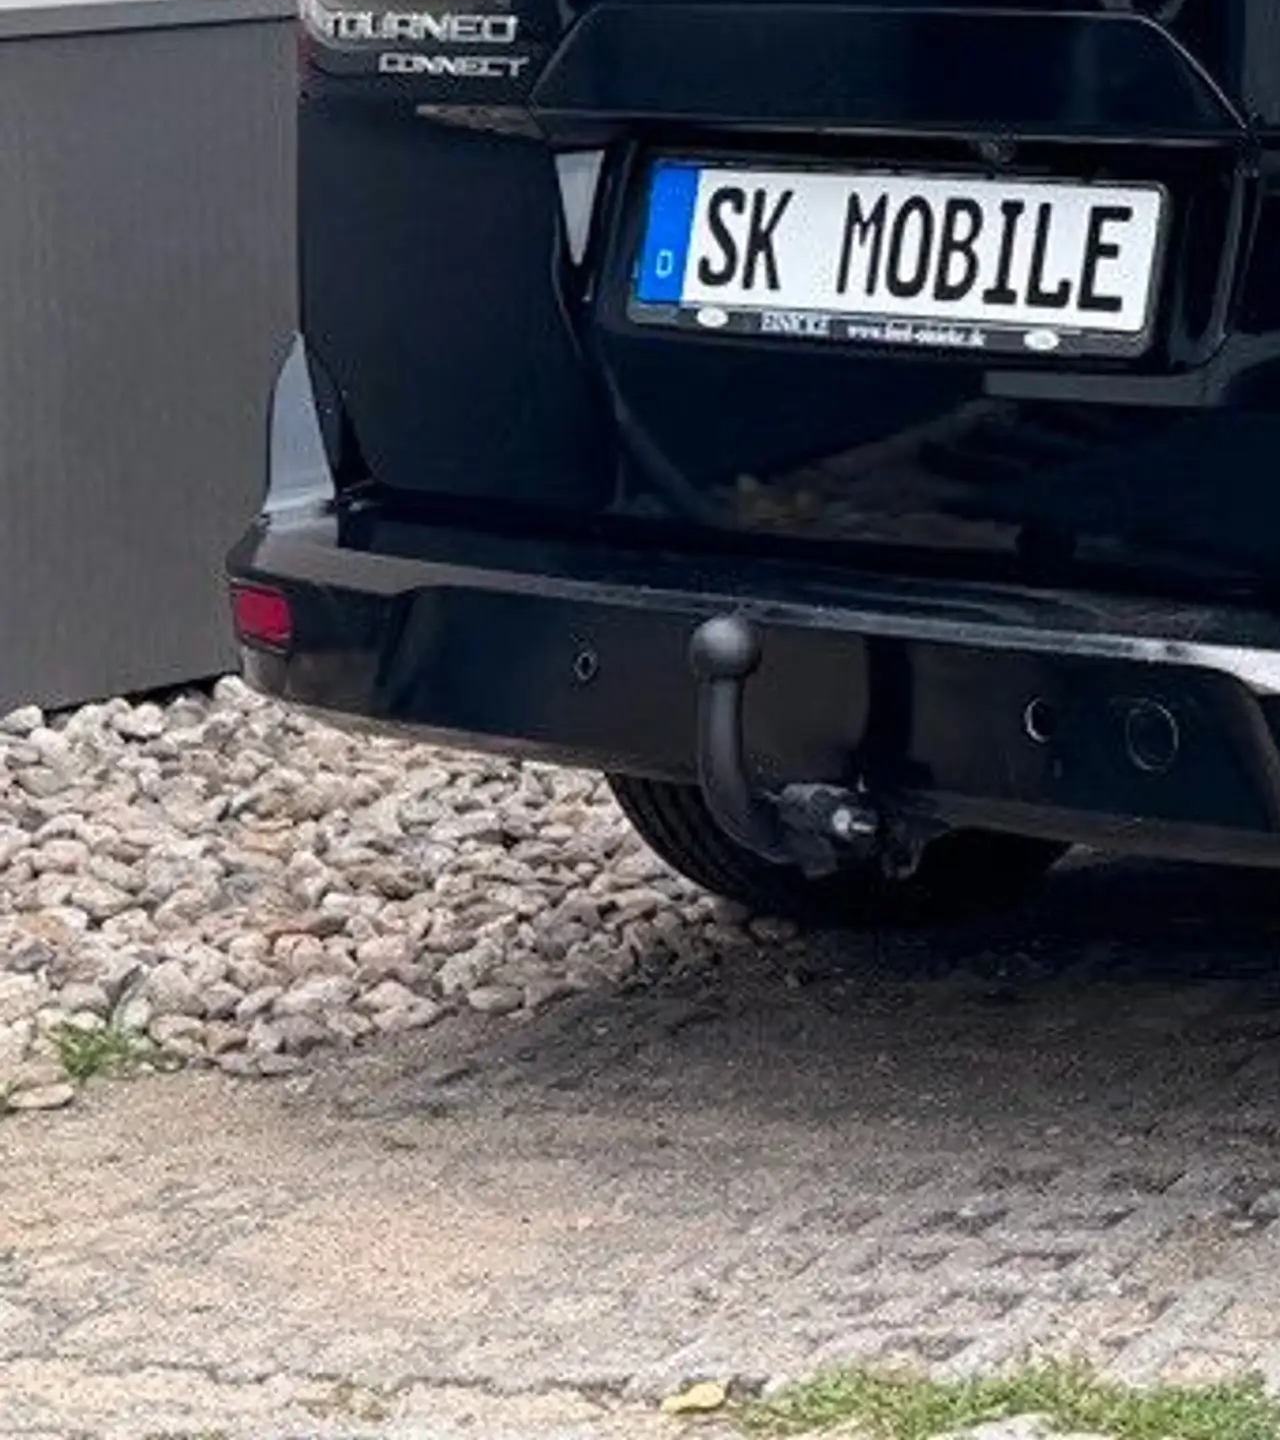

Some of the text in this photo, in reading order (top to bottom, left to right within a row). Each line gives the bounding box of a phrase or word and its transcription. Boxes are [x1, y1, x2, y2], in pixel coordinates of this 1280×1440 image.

[326, 11, 520, 44] TOURNEO
[378, 51, 531, 79] CONNECT
[654, 247, 675, 280] D
[697, 185, 1135, 313] SK MOBILE
